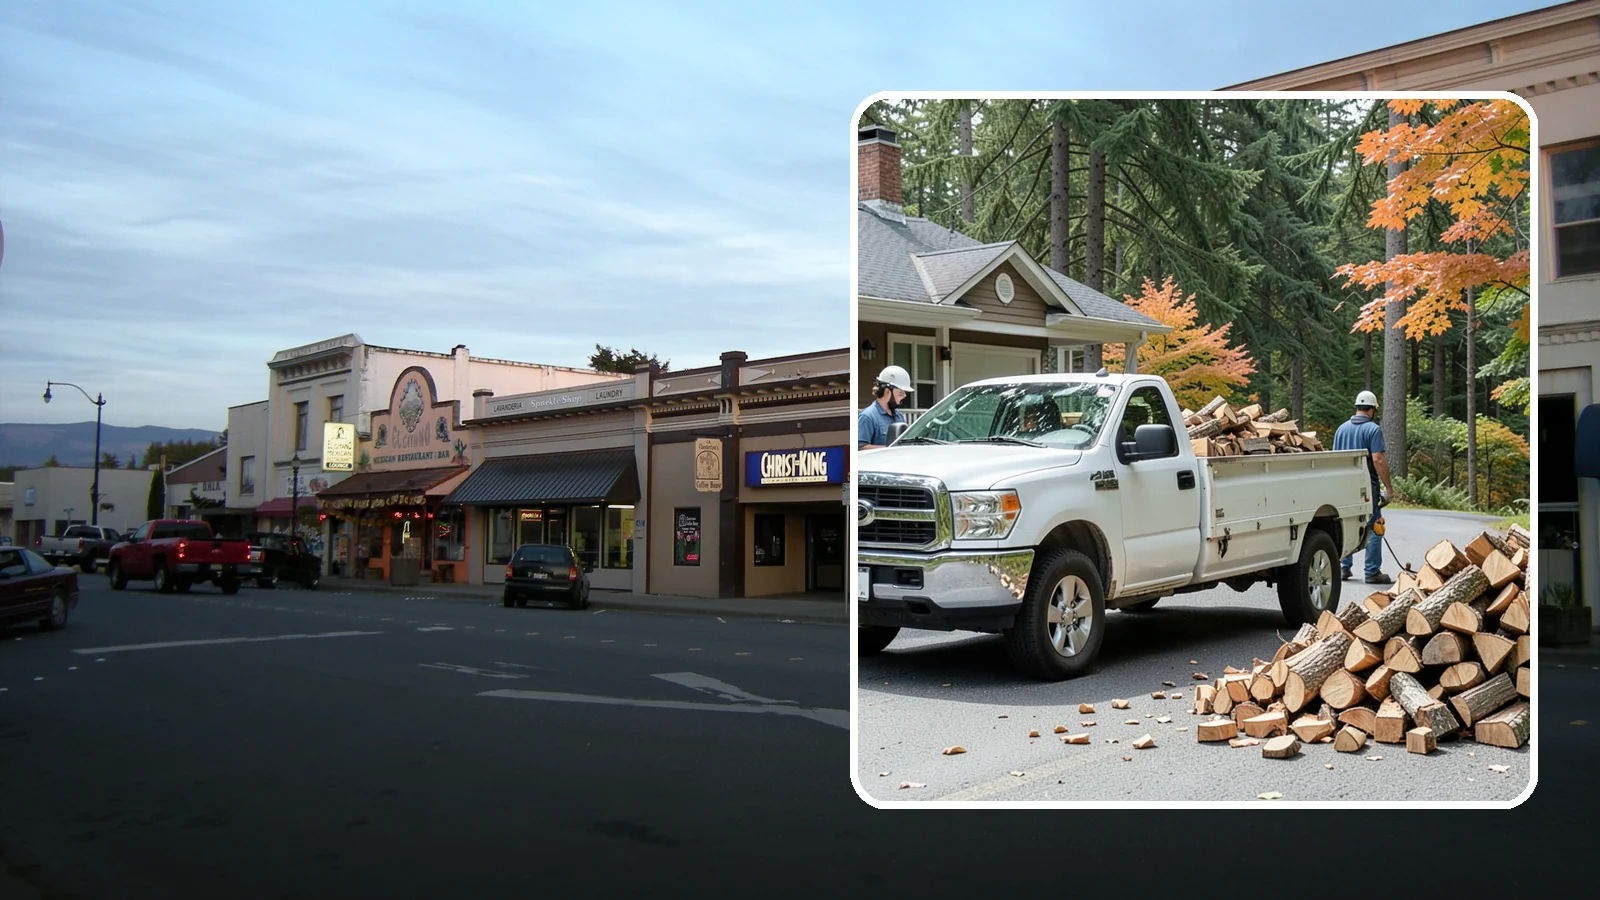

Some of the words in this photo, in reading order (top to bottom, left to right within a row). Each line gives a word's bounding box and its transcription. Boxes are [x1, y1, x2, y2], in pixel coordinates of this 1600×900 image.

[595, 389, 623, 400] LAUNDRY
[493, 402, 522, 413] LAVANDERIA
[530, 398, 560, 409] Sparkle
[562, 394, 582, 406] Shop
[373, 454, 396, 464] MEXICAN
[397, 451, 433, 462] RESTAURANT
[438, 450, 450, 458] BAR
[761, 452, 797, 478] CHRIST
[799, 449, 827, 476] KING
[696, 480, 709, 489] Coffee
[710, 480, 722, 489] House
